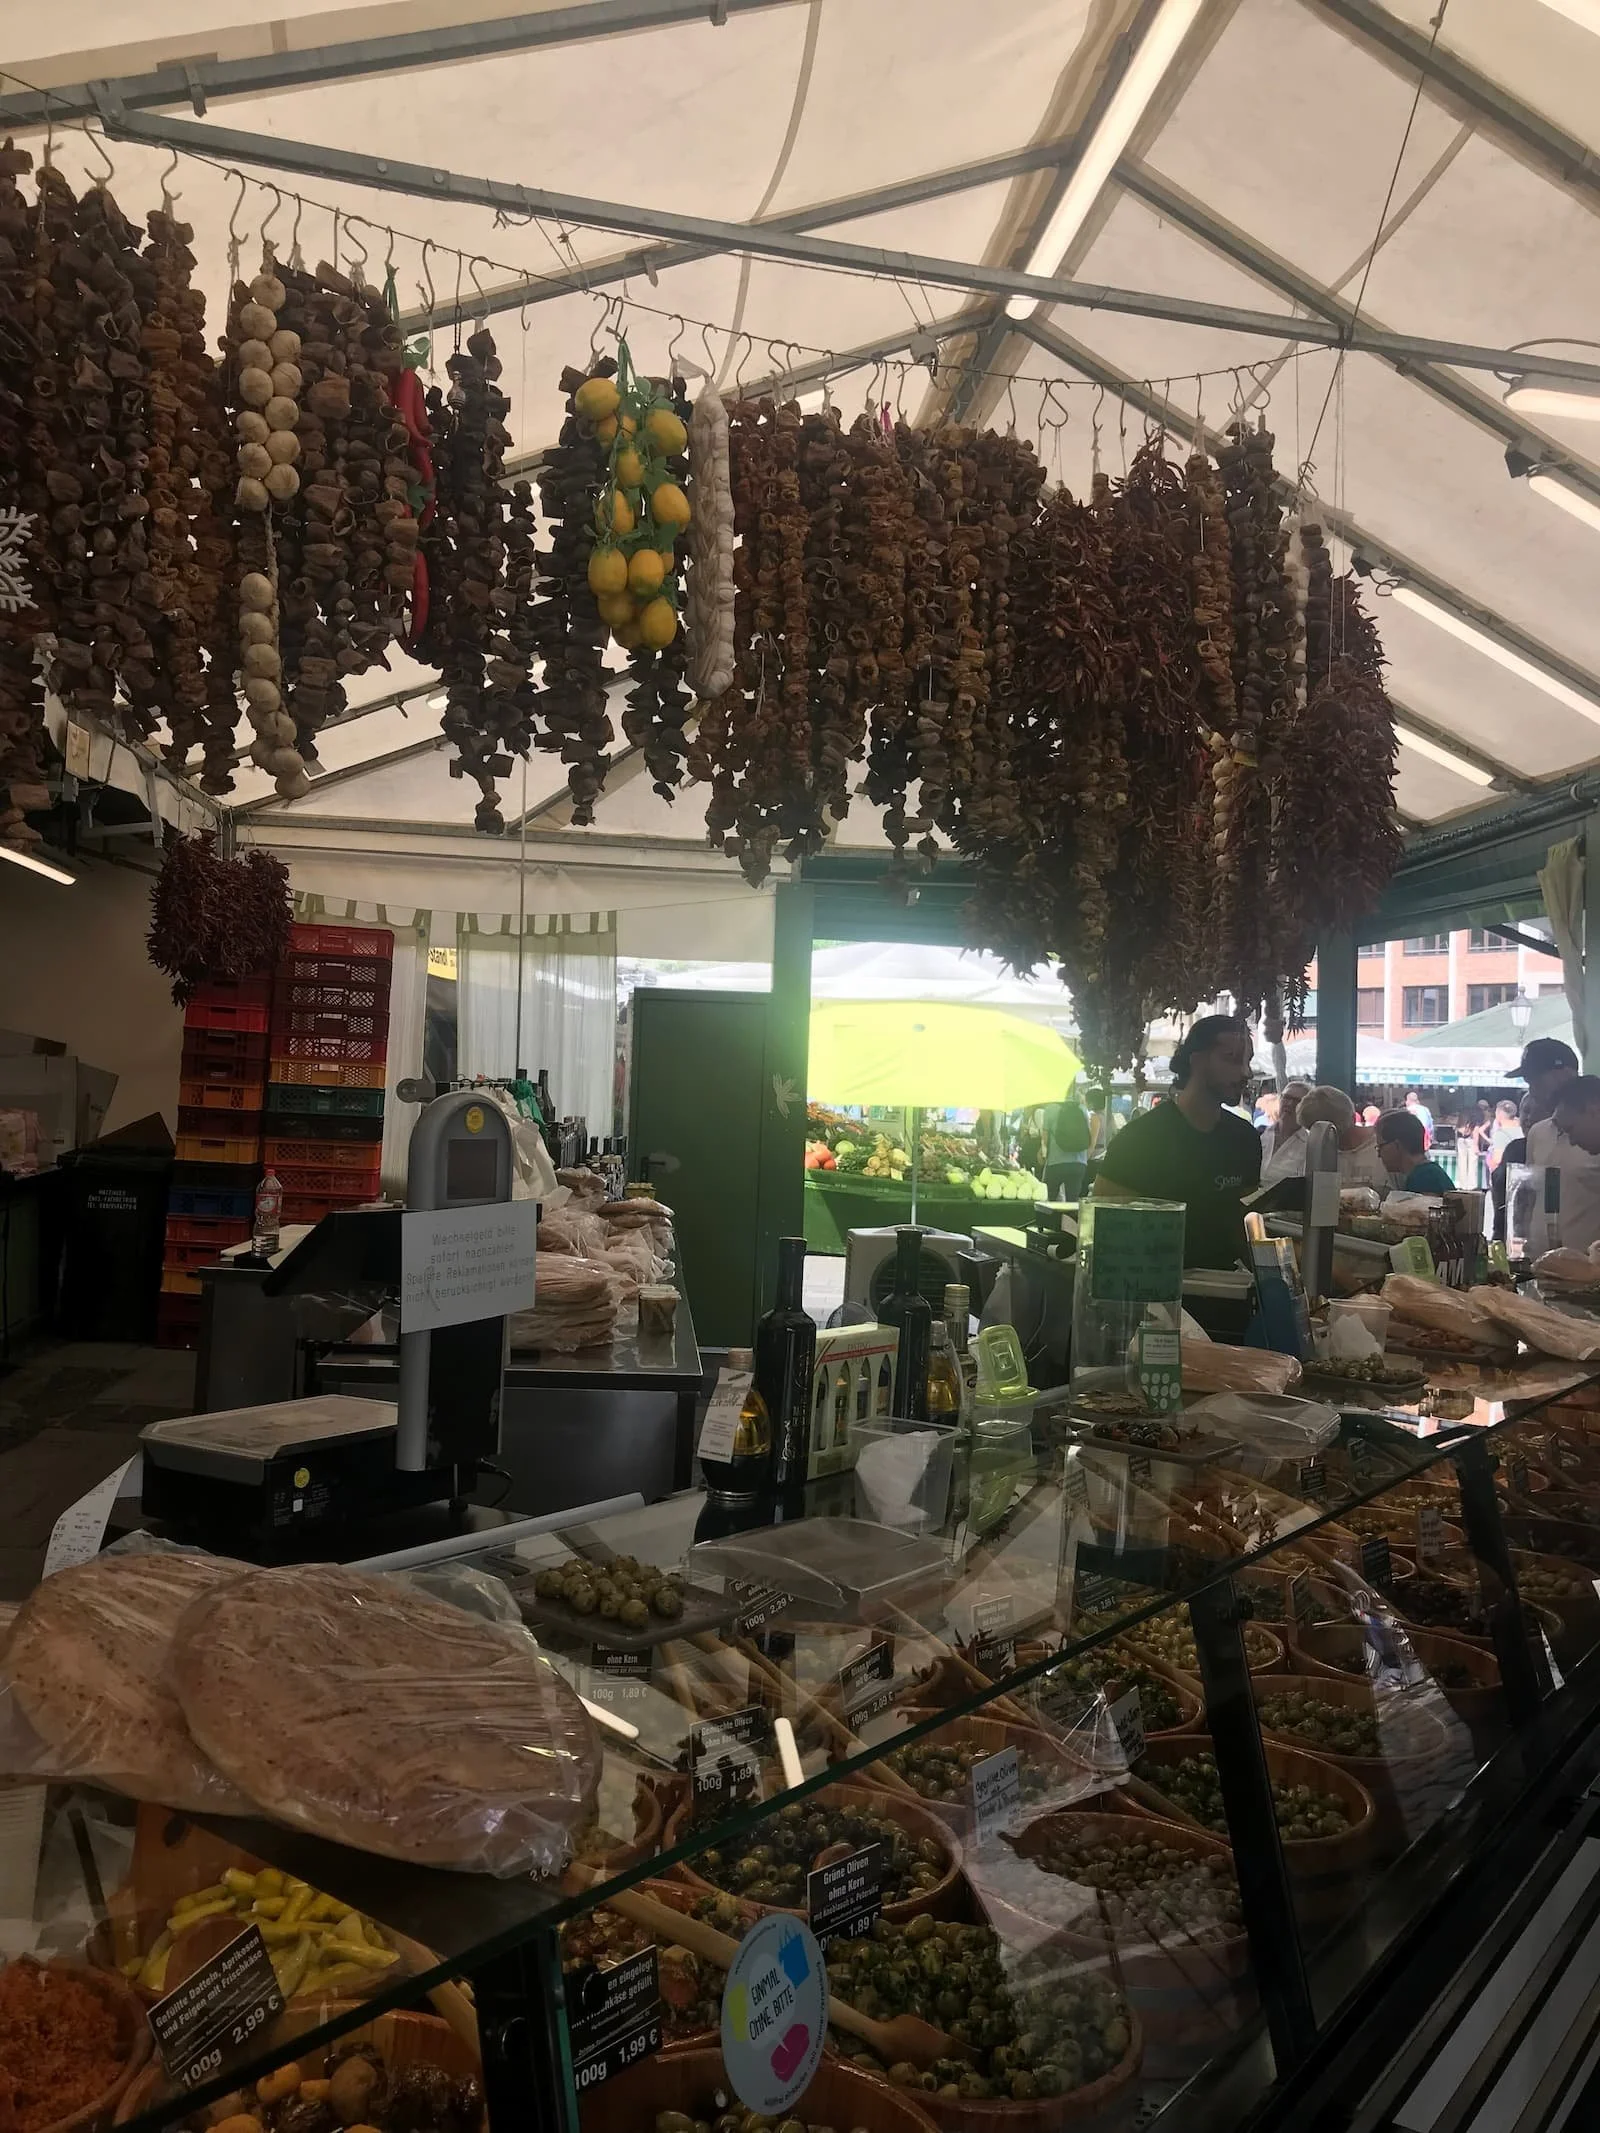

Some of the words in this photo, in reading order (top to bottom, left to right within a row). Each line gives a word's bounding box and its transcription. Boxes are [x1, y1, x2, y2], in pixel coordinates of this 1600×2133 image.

[431, 1228, 493, 1246] Wechselgeld
[430, 1248, 460, 1264] sofort
[745, 1613, 766, 1630] 100g
[607, 1654, 623, 1664] ohne
[623, 1654, 638, 1664] Kern
[592, 1688, 615, 1702] 100g
[851, 1710, 869, 1727] 100g
[696, 1776, 723, 1793] 100g
[731, 1766, 752, 1784] 1,89
[823, 1866, 847, 1886] Grüne
[846, 1856, 869, 1875] Oliven
[828, 1884, 848, 1901] ohne
[847, 1876, 865, 1892] Kern
[155, 1996, 190, 2028] Gefüllte
[188, 1971, 222, 2000] Datteln,
[221, 1936, 260, 1974] Aprikosen
[618, 1956, 654, 1985] eingelegt
[162, 2019, 180, 2040] und
[180, 1998, 208, 2026] Feigen
[207, 1984, 222, 2001] mit
[221, 1950, 263, 1989] Frischkäse
[628, 1974, 653, 2000] gefüllt
[751, 1967, 781, 2007] EINMAL
[749, 2005, 775, 2042] OHNE,
[773, 1984, 795, 2018] BITTE
[181, 2047, 223, 2089] 100g
[232, 2006, 266, 2045] 2,99
[268, 1994, 280, 2011] €
[574, 2060, 608, 2091] 100g
[618, 2034, 646, 2064] 1,99
[649, 2027, 658, 2046] €
